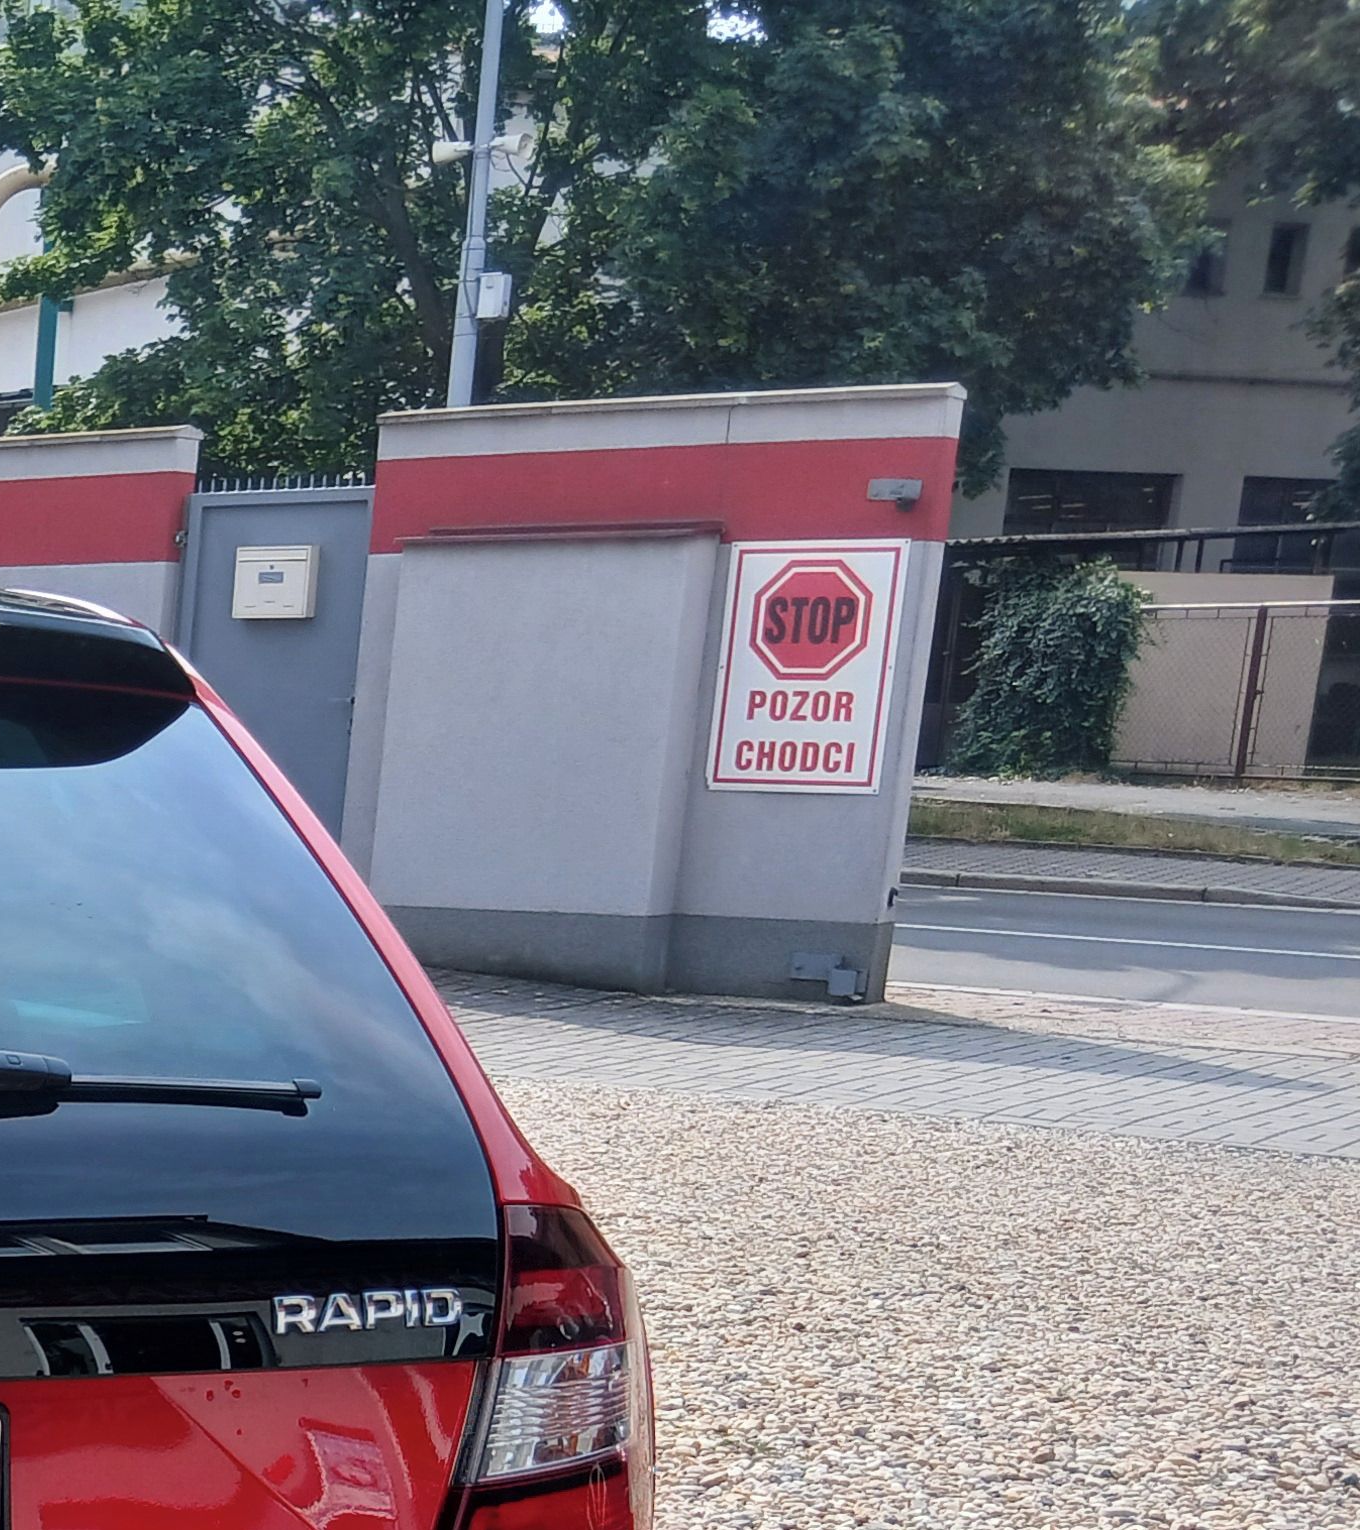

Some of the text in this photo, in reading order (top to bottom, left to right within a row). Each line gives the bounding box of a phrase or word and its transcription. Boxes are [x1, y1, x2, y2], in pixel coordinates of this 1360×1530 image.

[765, 596, 856, 645] STOP
[746, 690, 854, 722] POZOR
[734, 740, 855, 773] CHODCI
[274, 1288, 462, 1334] RAPID
